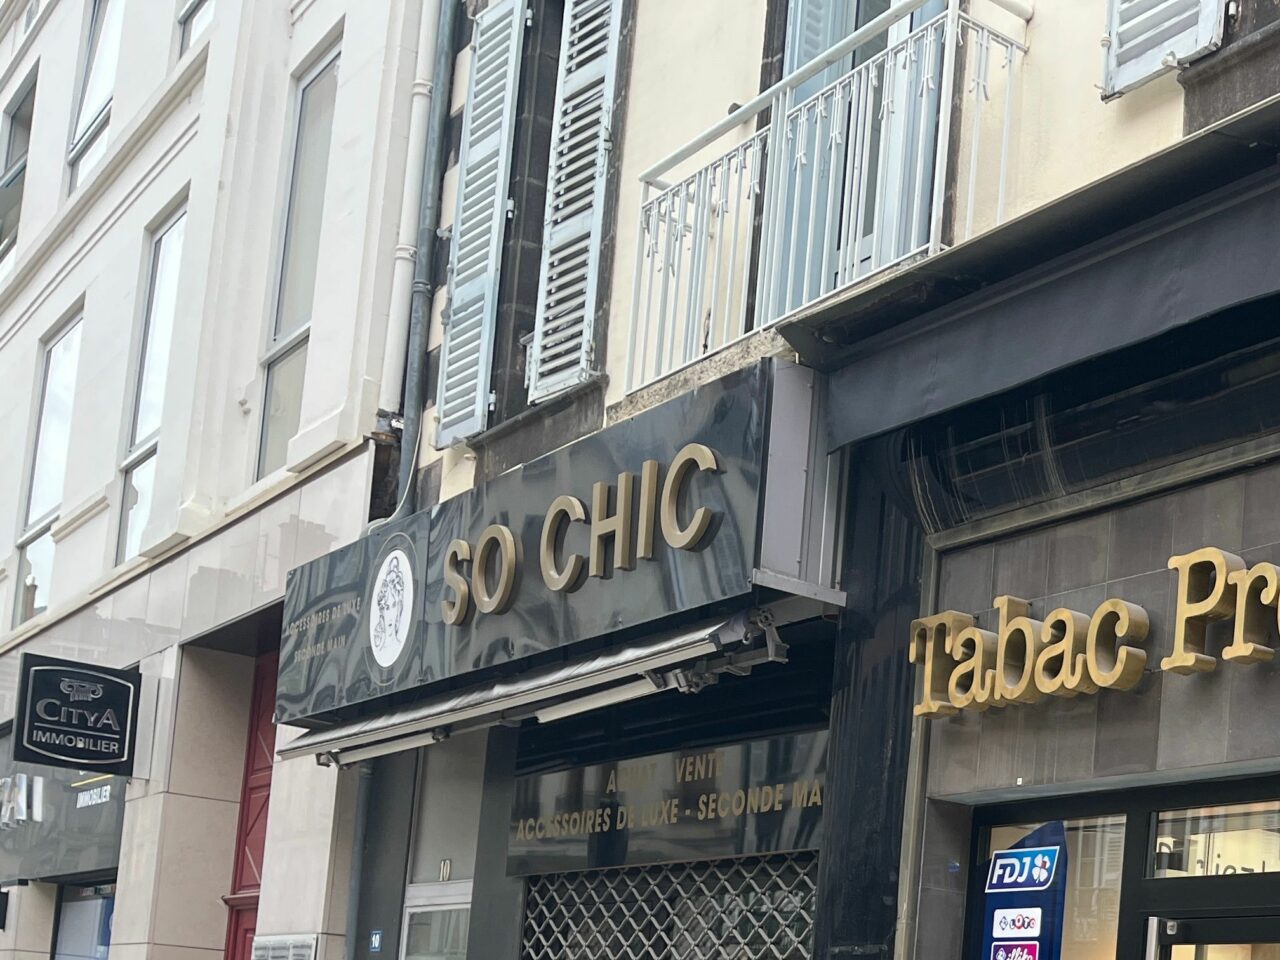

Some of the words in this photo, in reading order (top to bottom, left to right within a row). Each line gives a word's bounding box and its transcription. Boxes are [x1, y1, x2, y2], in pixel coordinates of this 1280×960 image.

[441, 523, 519, 626] SO
[540, 442, 719, 592] CHIC
[327, 635, 347, 652] MAIN
[909, 595, 1149, 718] Tabac
[32, 729, 120, 754] IMMOBILIER
[675, 752, 726, 783] VENTE
[515, 807, 611, 841] ACCESSOIRES
[616, 804, 636, 831] DE
[641, 798, 679, 827] LUXE
[697, 783, 784, 822] SECONDE
[439, 859, 451, 882] 10
[992, 856, 1031, 885] FDJ
[1009, 913, 1037, 931] LOTO
[371, 934, 380, 948] 10
